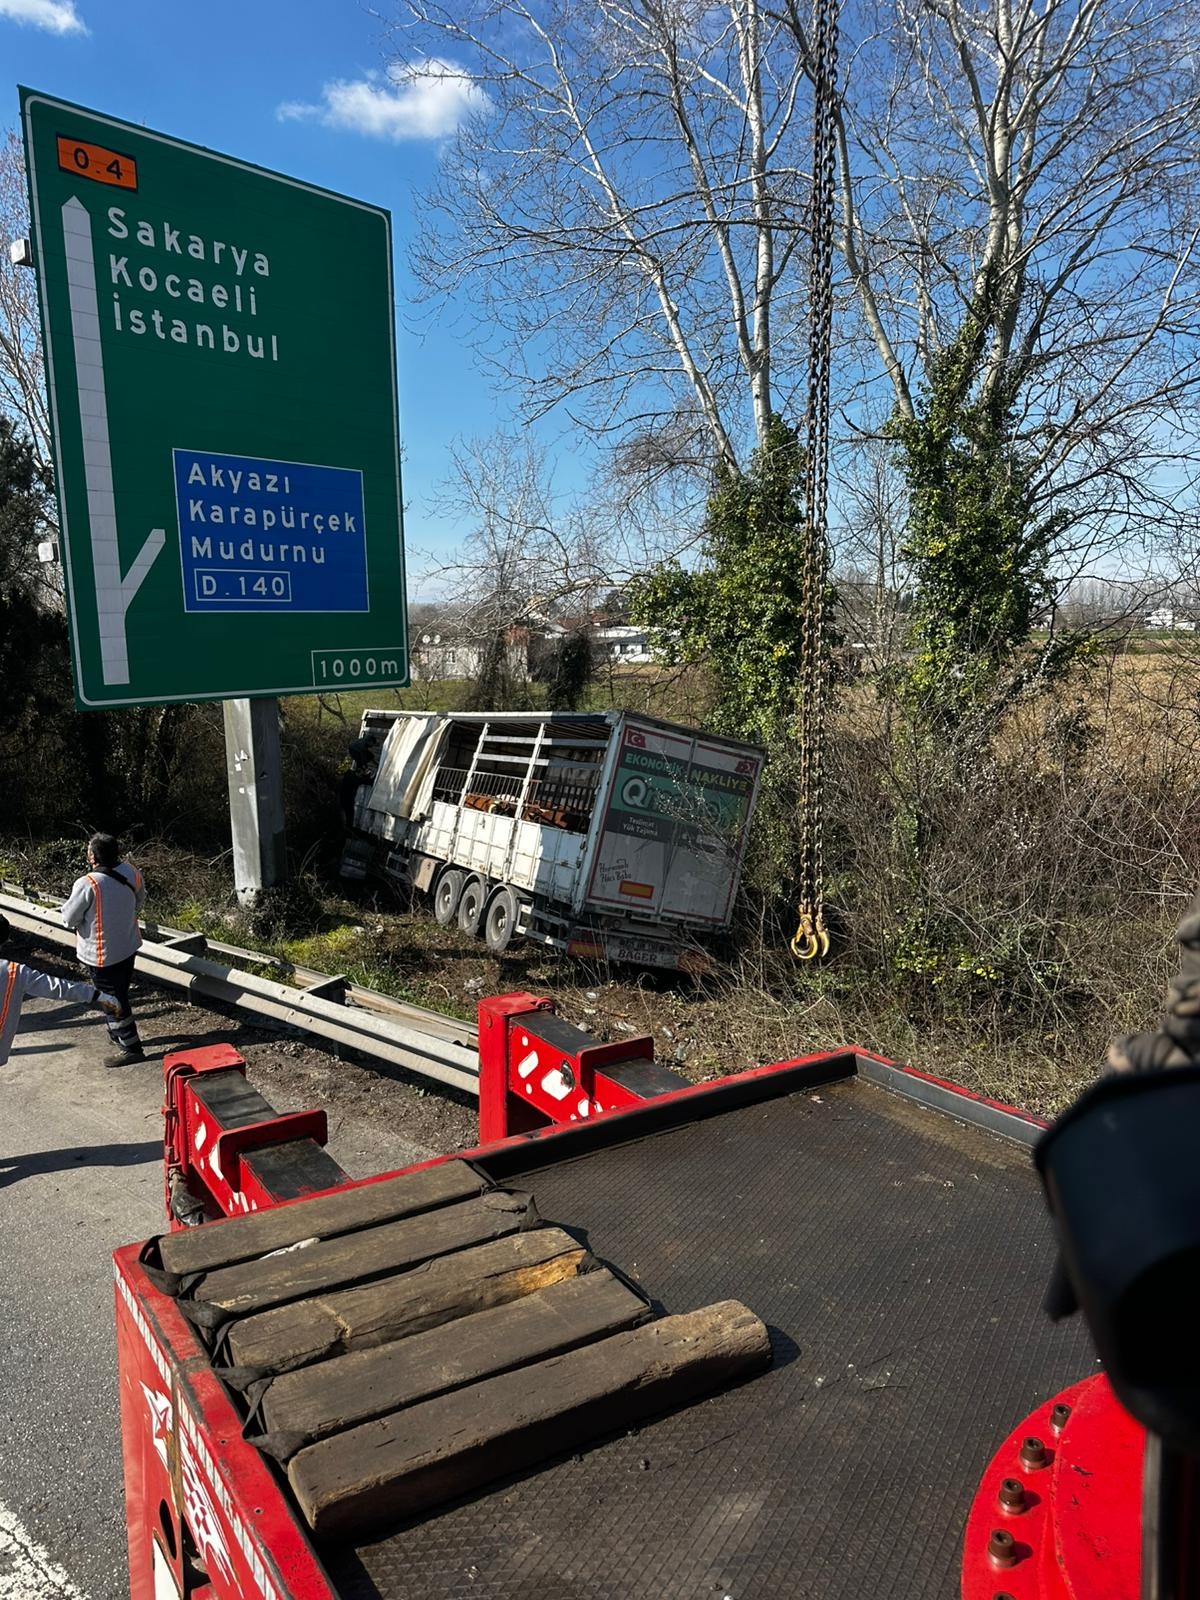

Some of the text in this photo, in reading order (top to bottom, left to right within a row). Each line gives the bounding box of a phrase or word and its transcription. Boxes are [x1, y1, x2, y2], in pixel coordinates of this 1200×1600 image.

[107, 206, 270, 277] Sakarya
[110, 254, 257, 316] Kocaeli
[113, 292, 279, 361] İstanbul
[188, 463, 290, 494] Akyazı
[189, 499, 356, 534] Karapürçek
[191, 535, 326, 564] Mudurnu
[320, 657, 398, 678] 1000m
